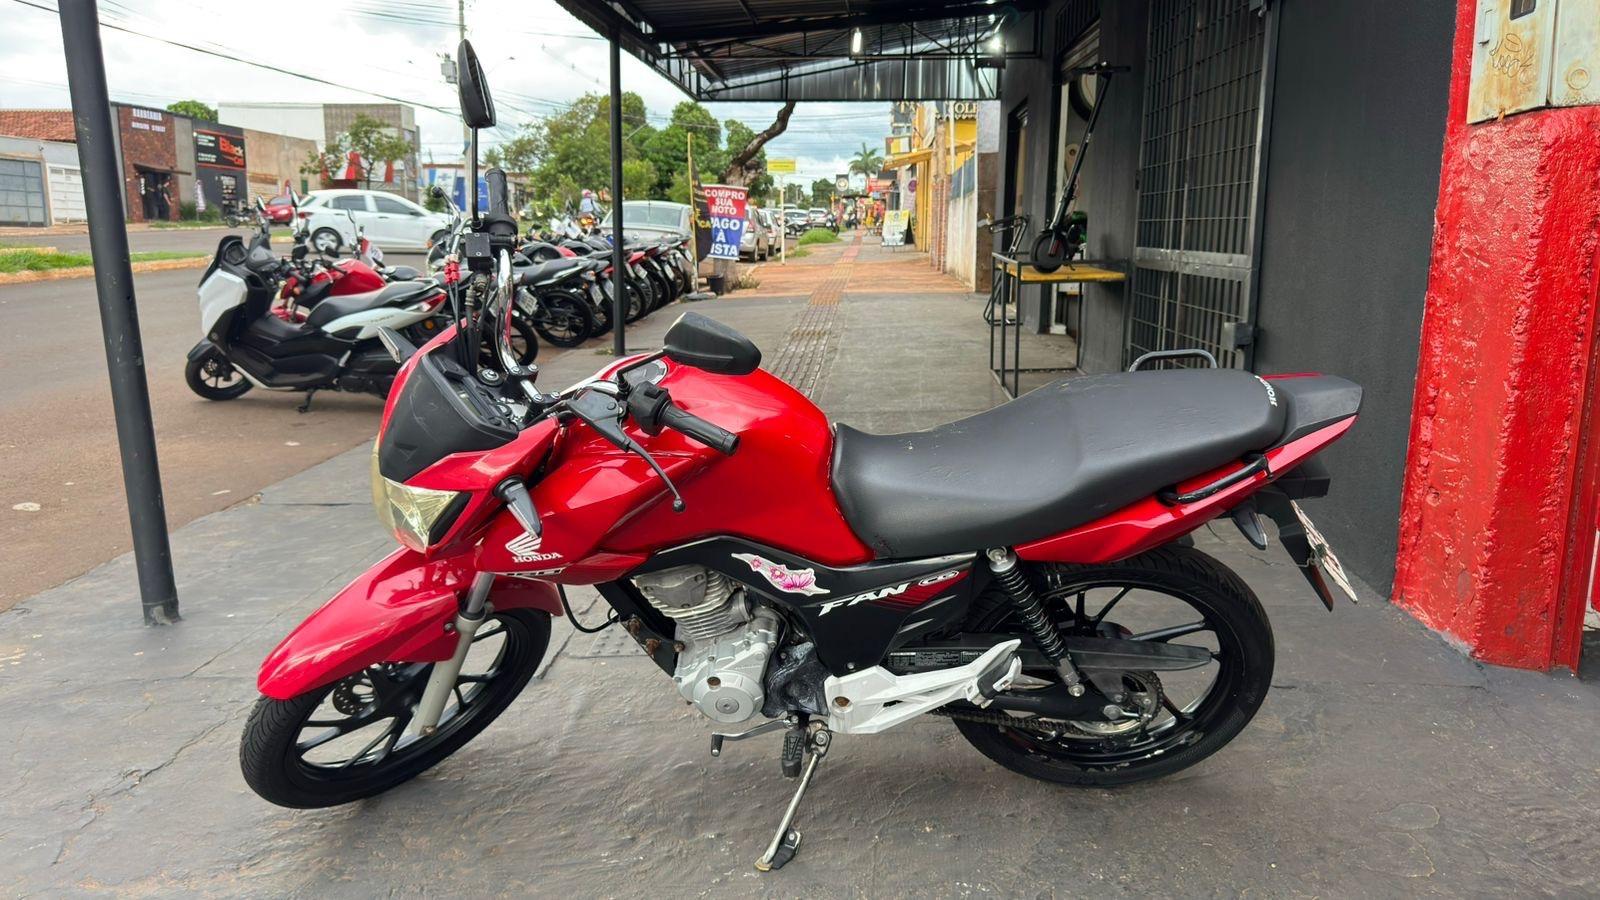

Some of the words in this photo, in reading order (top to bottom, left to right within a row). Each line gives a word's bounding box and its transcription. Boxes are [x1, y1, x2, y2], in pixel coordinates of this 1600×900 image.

[704, 189, 746, 200] COMPRO
[715, 198, 733, 208] SUA
[711, 205, 737, 216] MOTO
[711, 216, 741, 231] AGO
[710, 243, 738, 256] ISTA
[512, 551, 564, 564] HONDA
[818, 582, 912, 617] FAN
